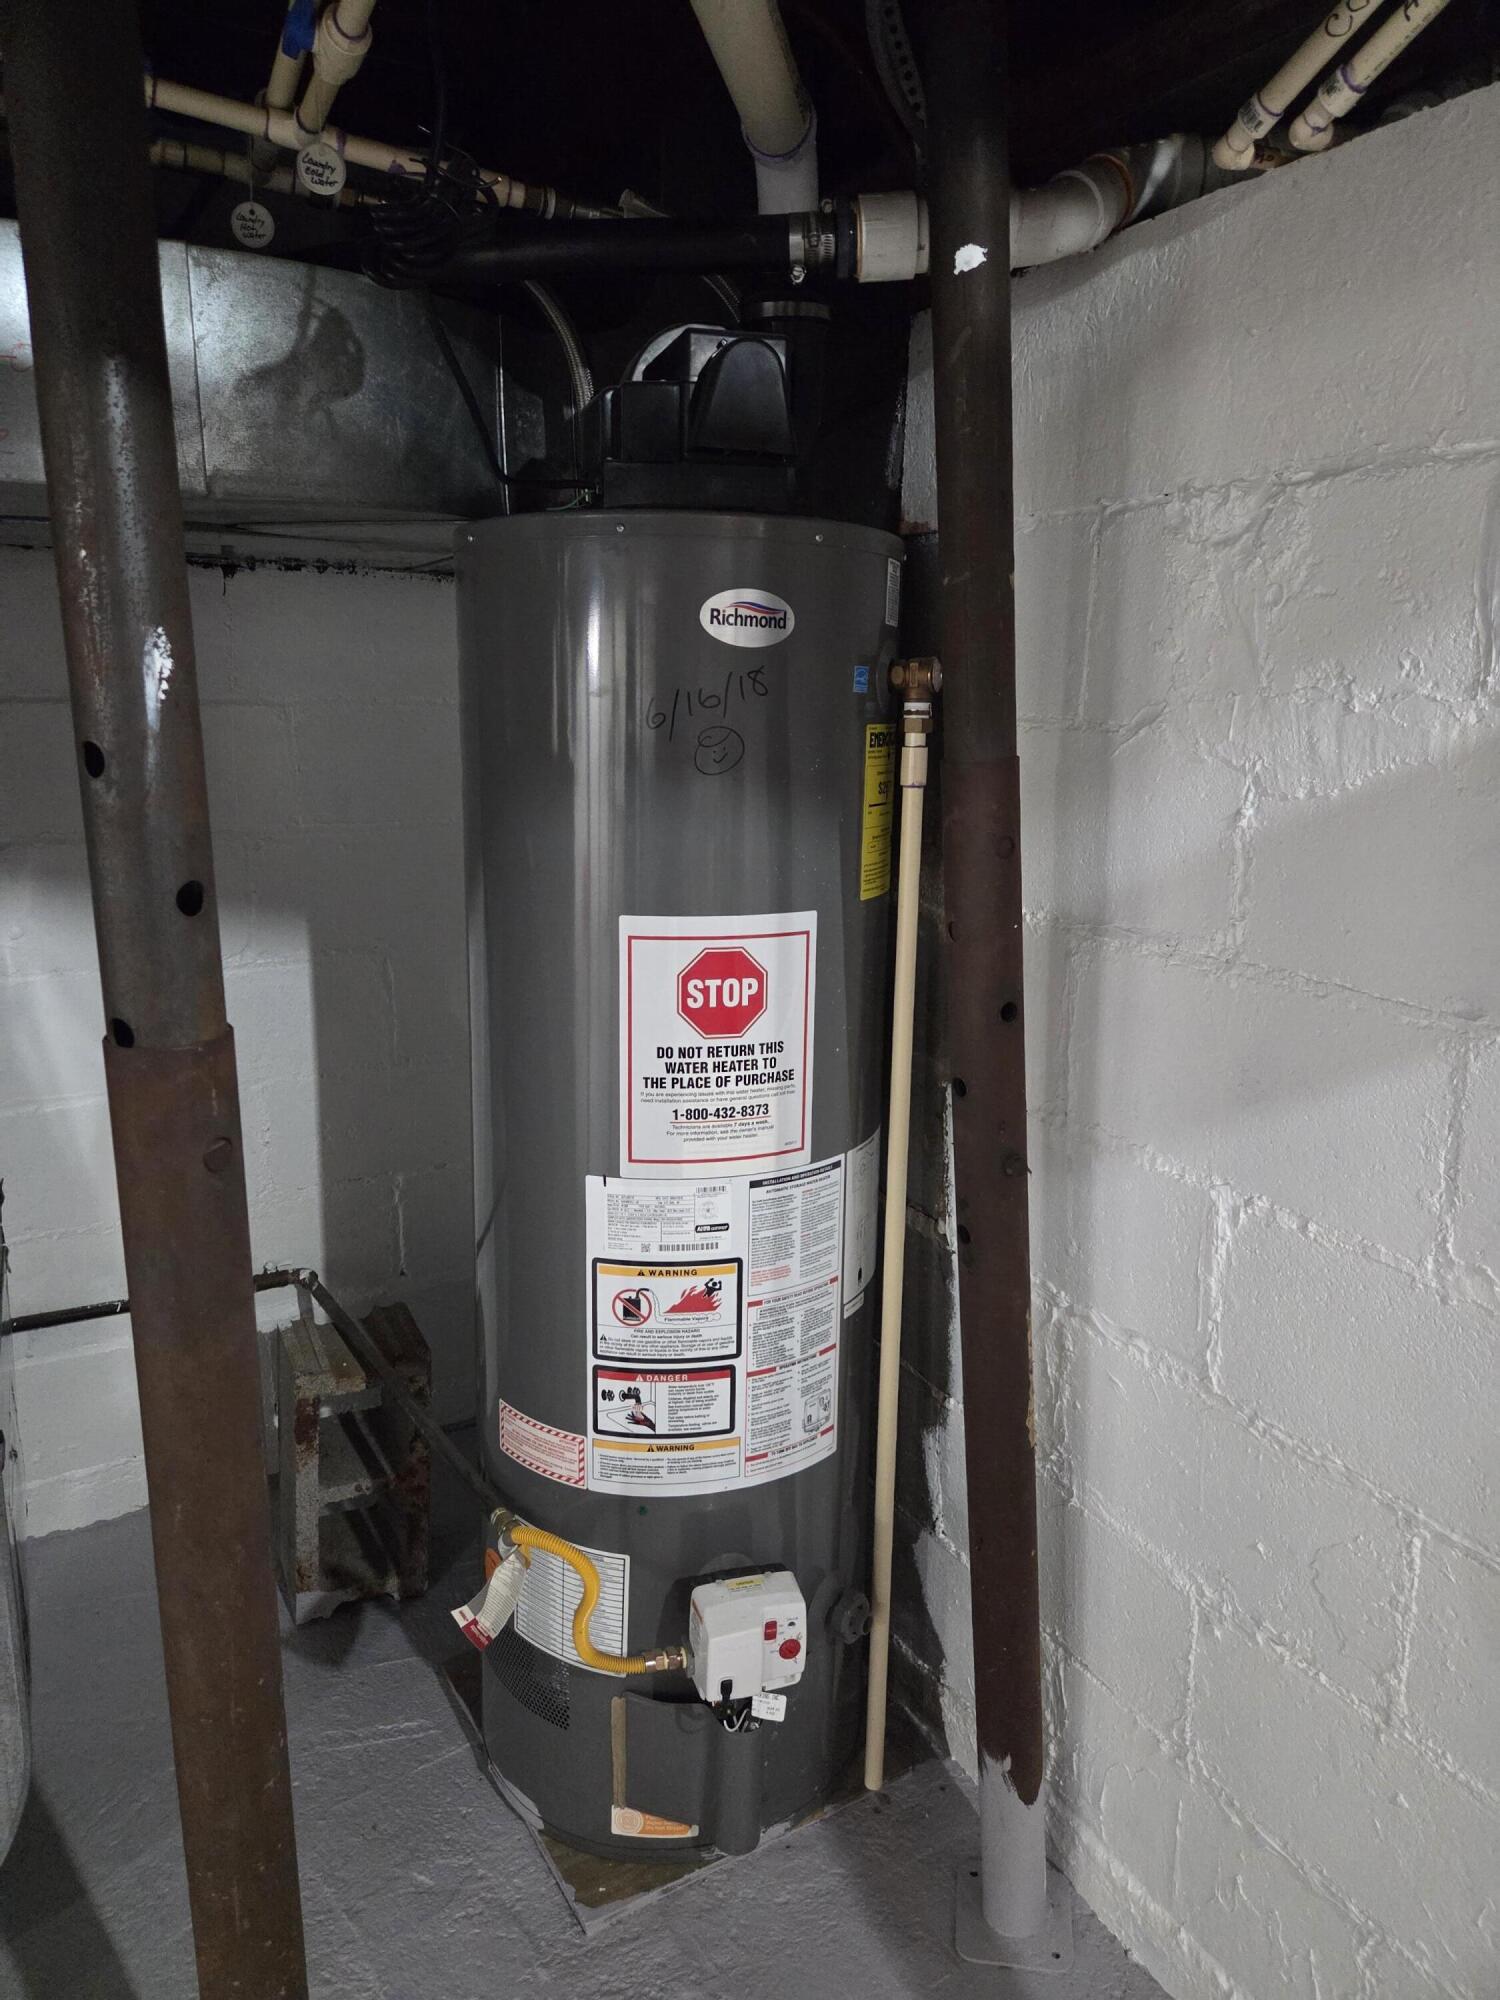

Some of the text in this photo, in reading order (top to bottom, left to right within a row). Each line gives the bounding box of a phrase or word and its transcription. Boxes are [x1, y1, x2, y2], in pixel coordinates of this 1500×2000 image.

[709, 607, 787, 630] Richmond
[646, 665, 769, 743] 6/16/18
[686, 977, 759, 1009] STOP
[656, 1041, 784, 1059] DO NOT RETURN THIS
[665, 1057, 777, 1074] WATER HEATER TO
[643, 1068, 795, 1089] THE PLACE OF PURCHASE
[672, 1103, 769, 1121] 1-800-432-8373
[646, 1374, 689, 1382] DANGER
[656, 1444, 695, 1452] WARNING
